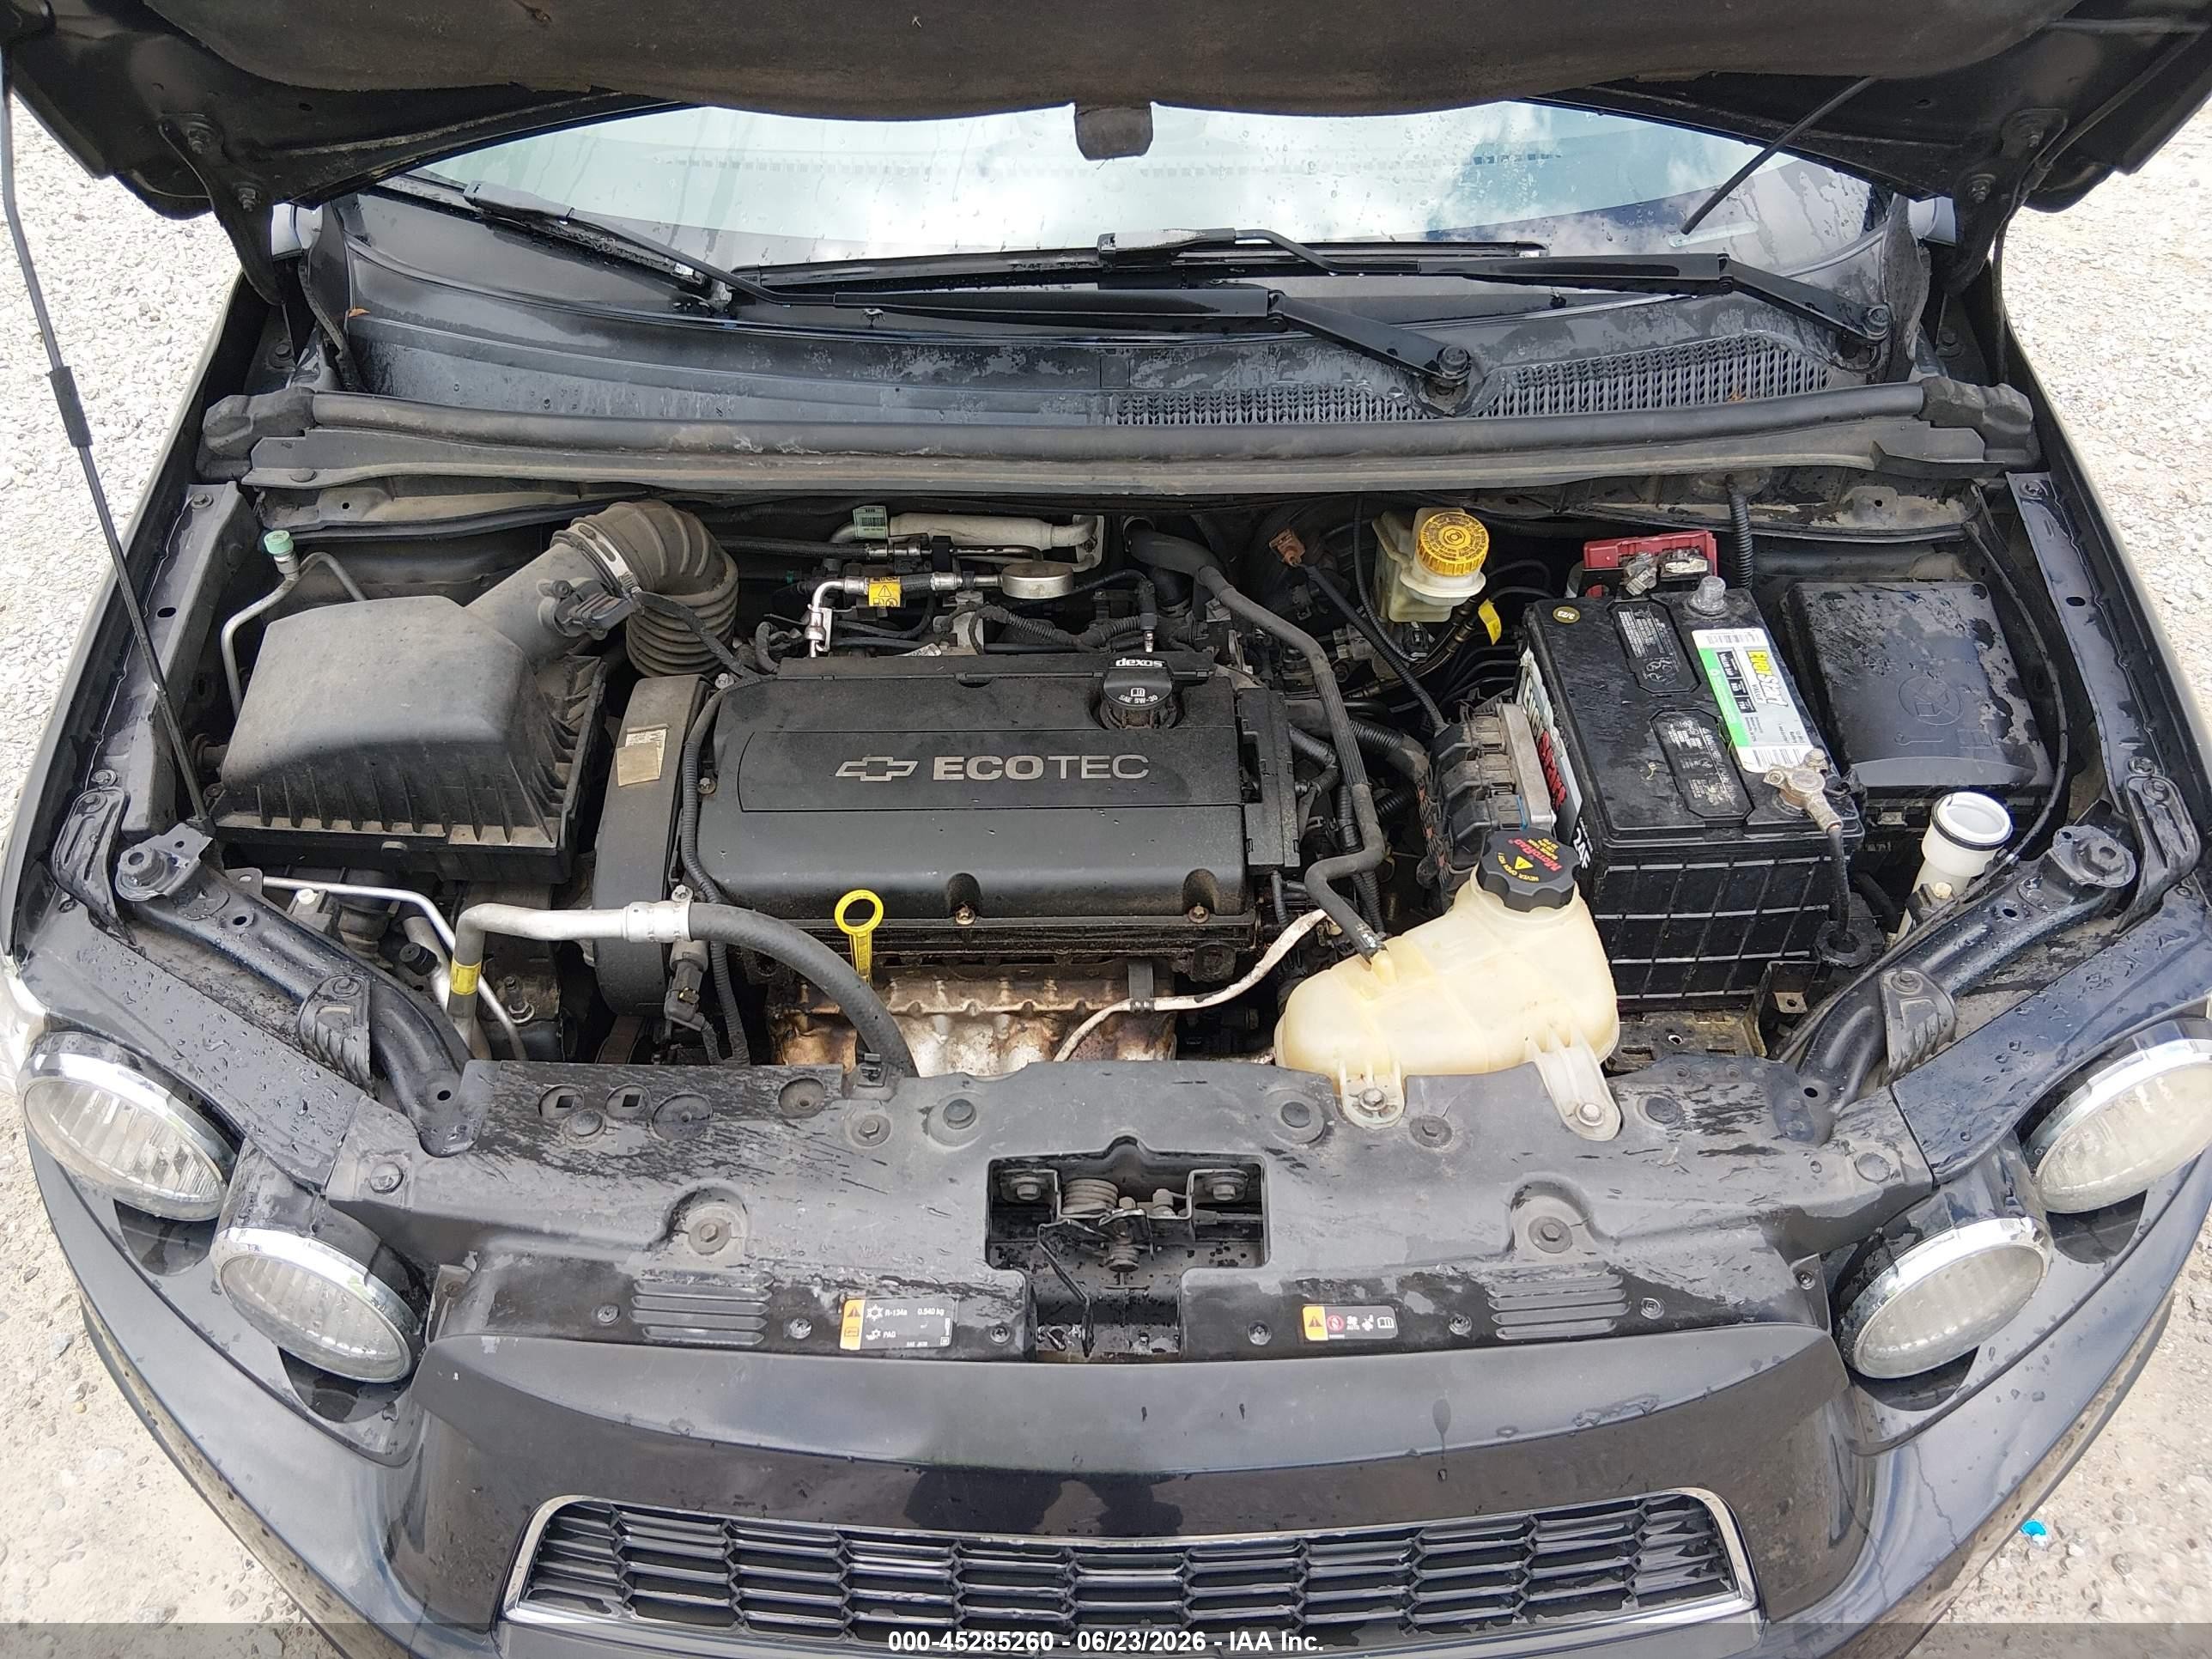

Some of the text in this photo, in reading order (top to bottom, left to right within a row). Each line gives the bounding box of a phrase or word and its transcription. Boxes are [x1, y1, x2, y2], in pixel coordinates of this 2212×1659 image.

[1115, 658, 1164, 667] dexos
[1118, 694, 1158, 704] SAE 5W-30
[1752, 684, 1764, 702] VALUE
[933, 755, 1149, 781] ECOTEC
[1573, 827, 1591, 869] 24F
[1503, 864, 1518, 877] OPEN
[1517, 872, 1540, 883] NEVER
